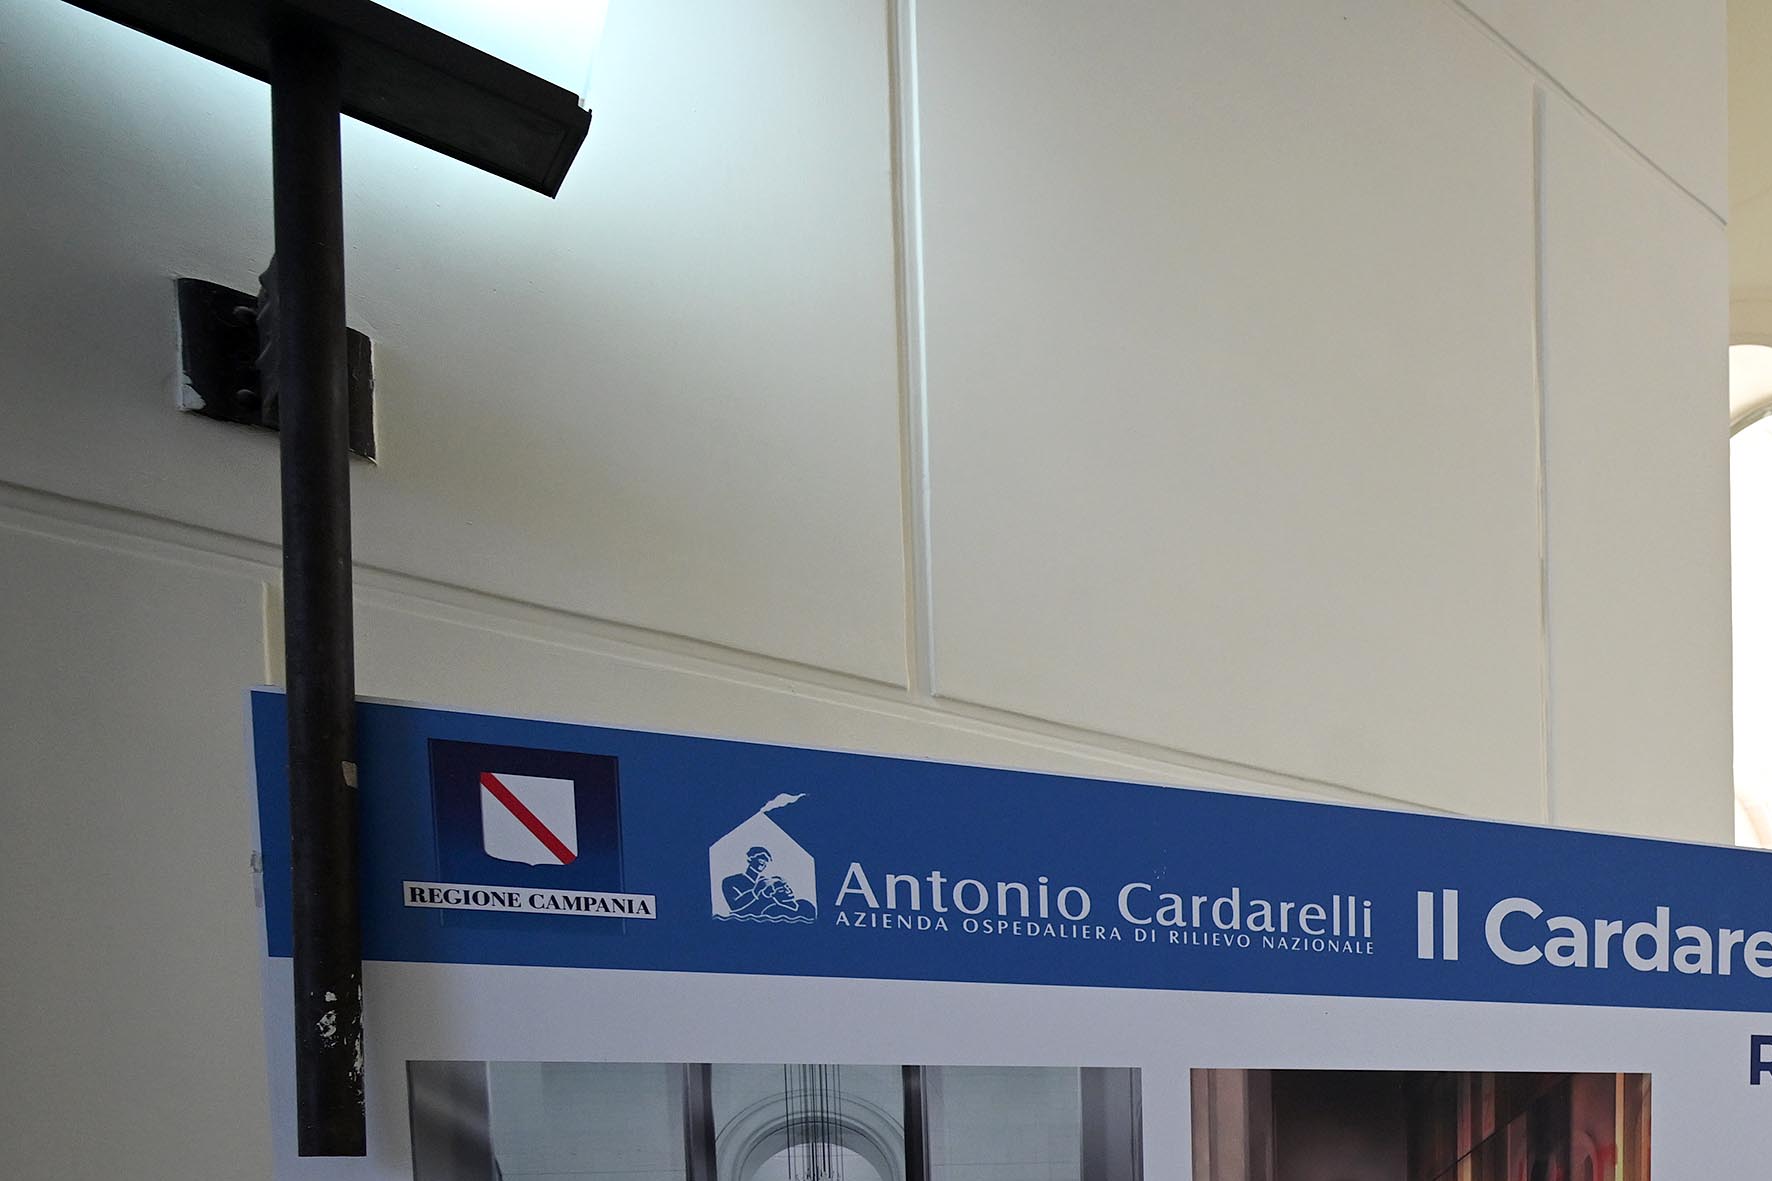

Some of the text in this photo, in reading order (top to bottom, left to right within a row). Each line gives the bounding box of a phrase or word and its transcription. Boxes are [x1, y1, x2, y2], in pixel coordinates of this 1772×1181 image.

[409, 886, 651, 915] REGIONE CAMPANIA
[835, 861, 1372, 938] Antonio Cardarelli
[1415, 889, 1460, 962] Il
[836, 911, 1374, 955] AZIENDA OSPEDALIERA DI RILIEVO NAZIONALE
